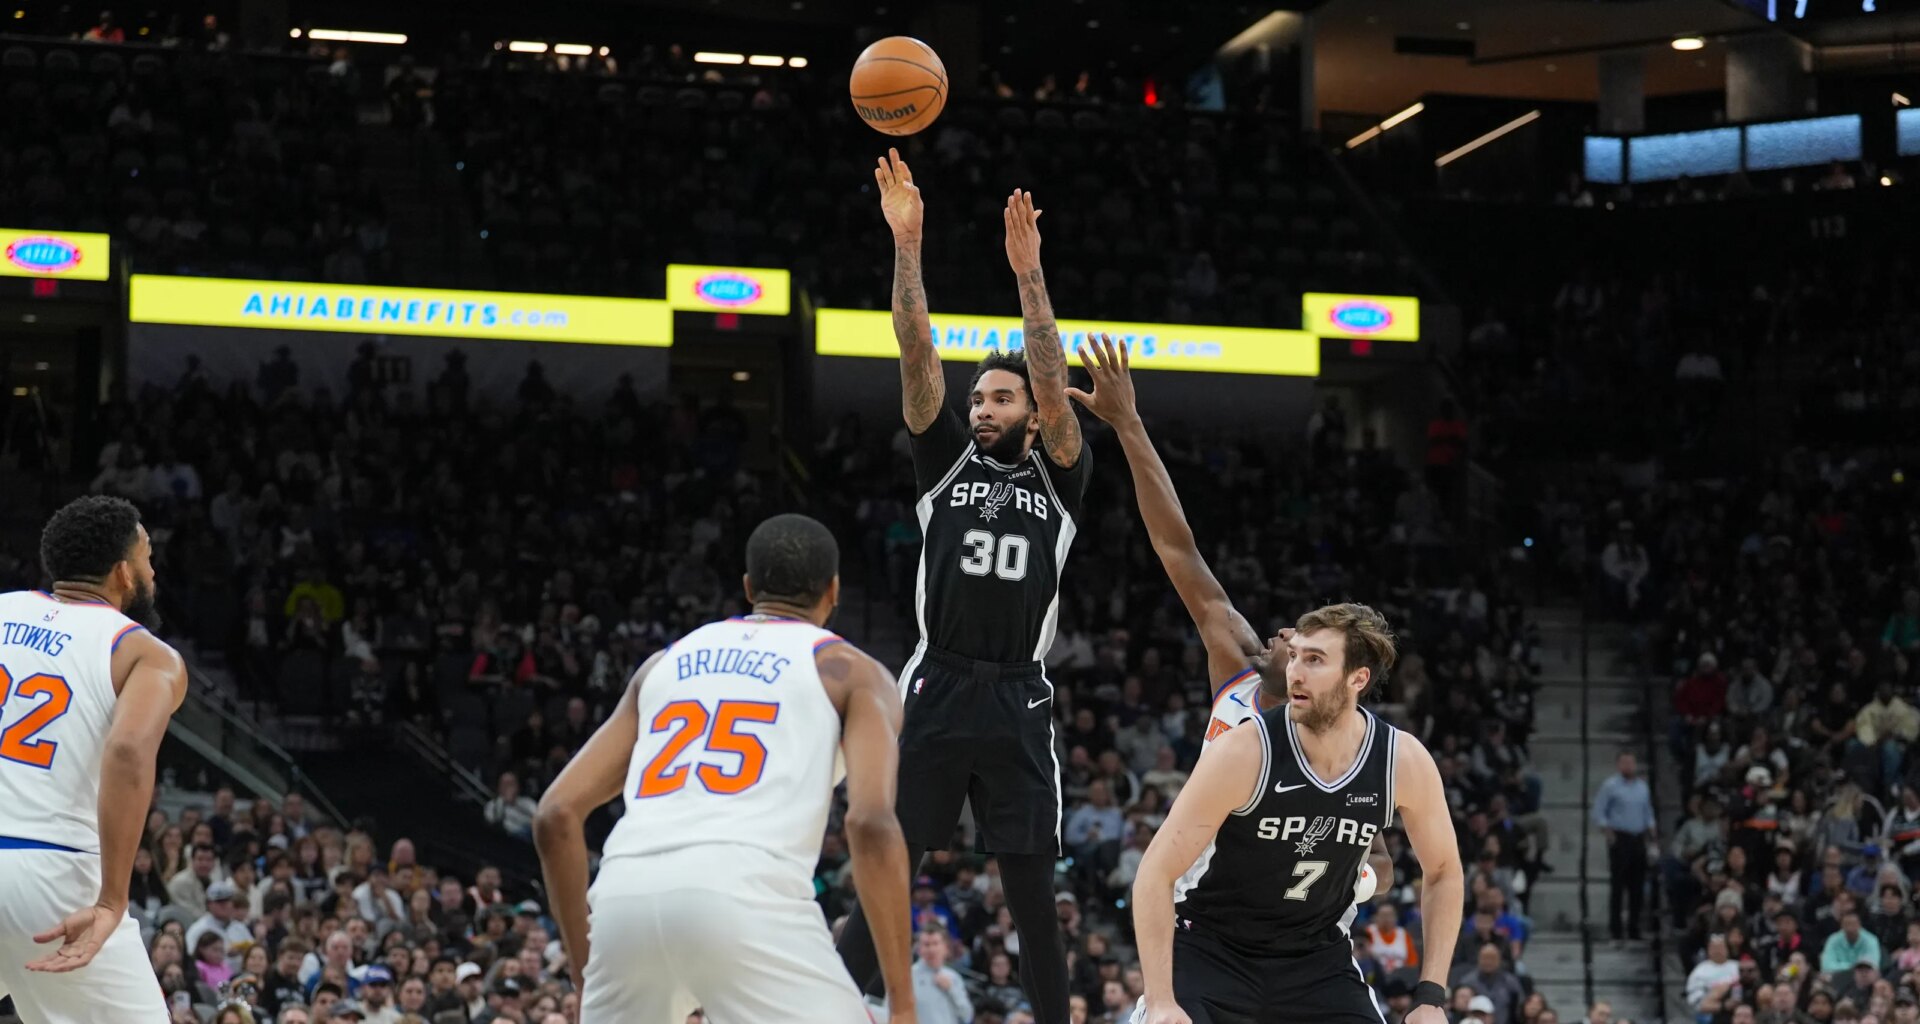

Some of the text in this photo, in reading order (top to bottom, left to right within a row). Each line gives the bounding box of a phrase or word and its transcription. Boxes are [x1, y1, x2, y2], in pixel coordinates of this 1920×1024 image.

[857, 103, 916, 121] Wilson
[243, 293, 568, 326] AHIABENEFITS.com
[1007, 469, 1031, 480] LEDGER
[950, 481, 1048, 522] SPURS
[960, 529, 1030, 581] 30
[3, 622, 72, 657] TOWNS
[677, 648, 790, 684] BRIDGES
[0, 663, 74, 770] 2
[635, 699, 780, 799] 25
[1257, 816, 1378, 857] SPURS
[1283, 860, 1329, 901] 7
